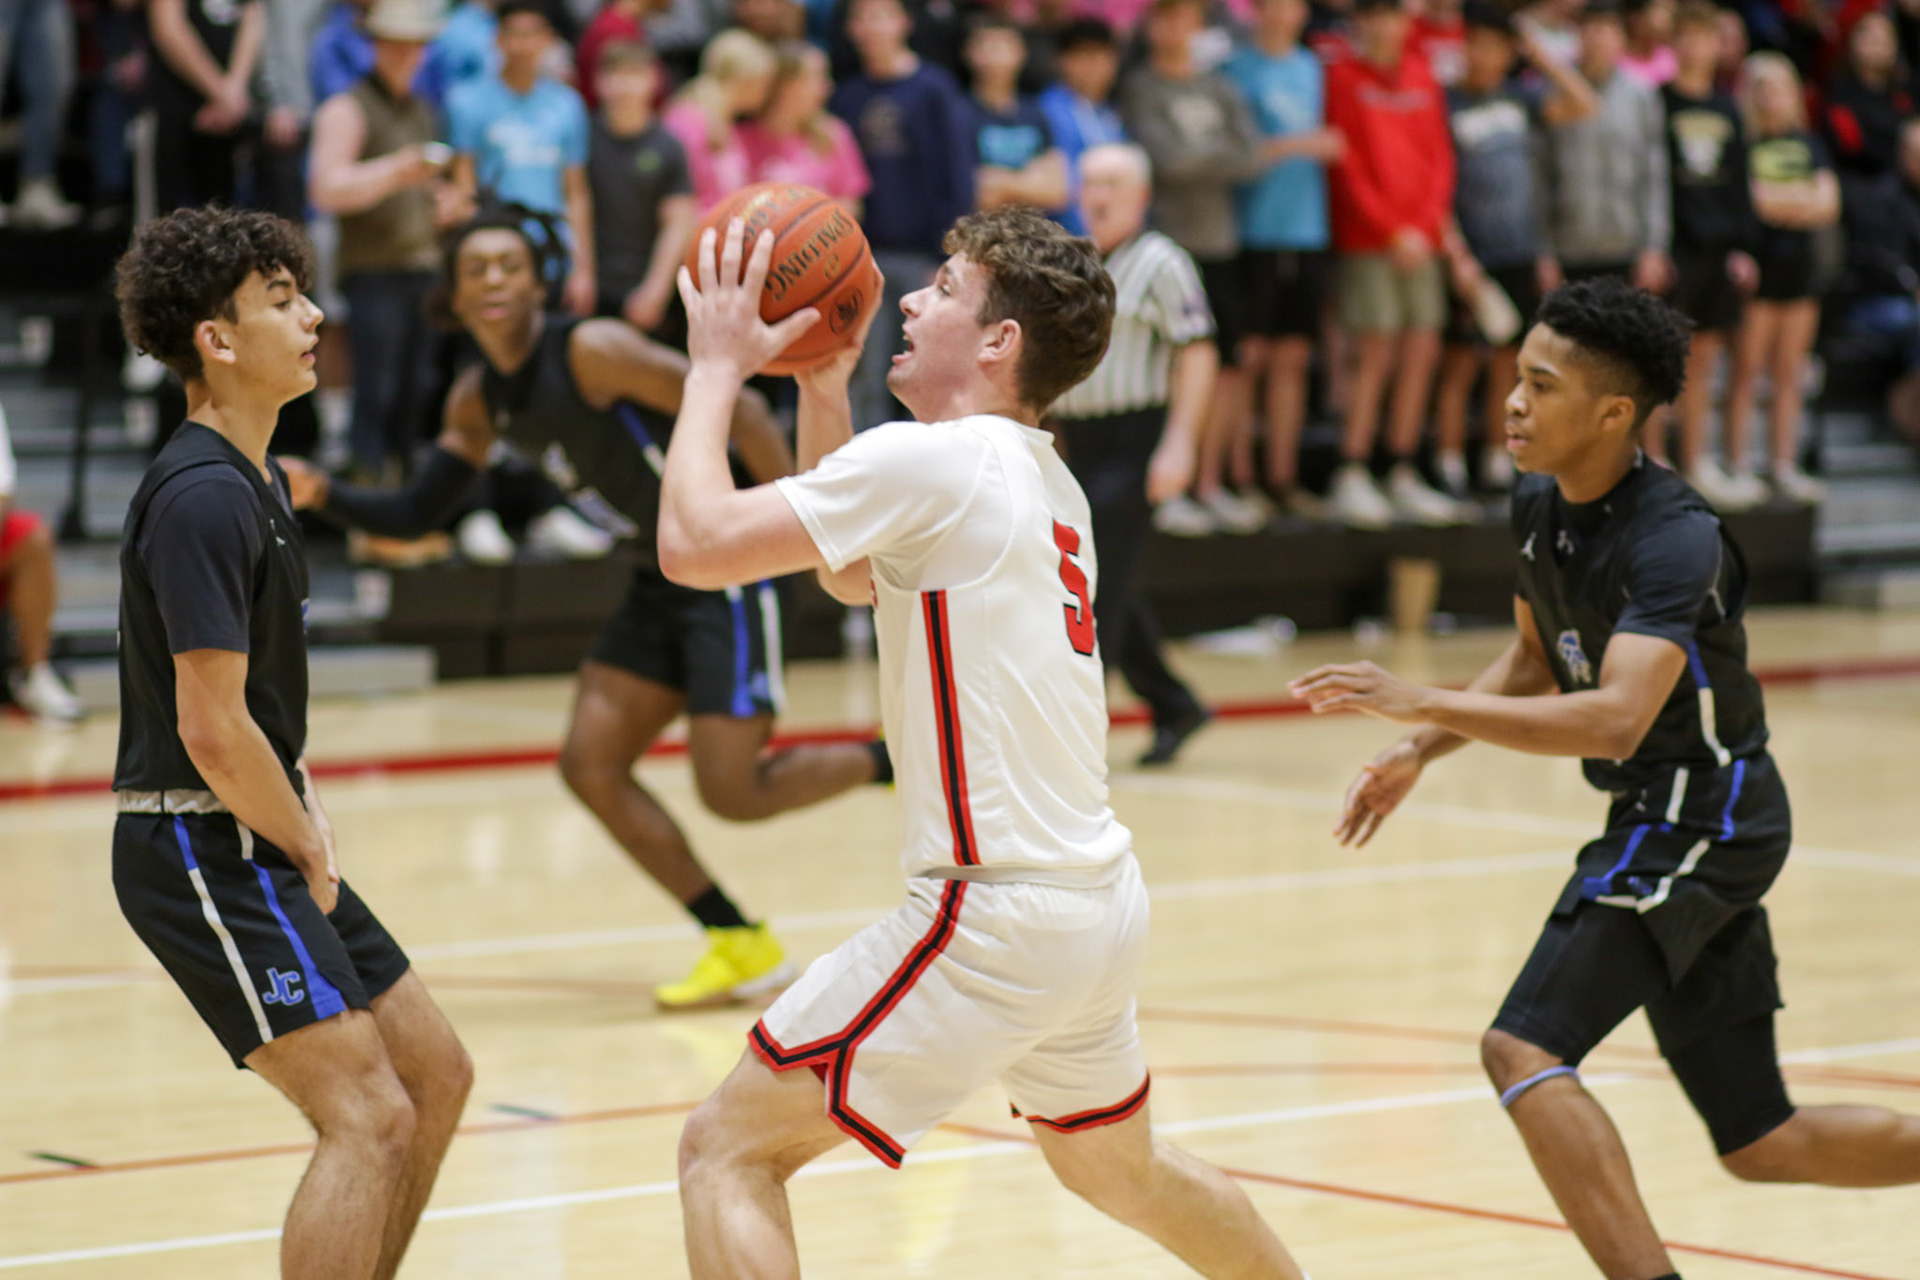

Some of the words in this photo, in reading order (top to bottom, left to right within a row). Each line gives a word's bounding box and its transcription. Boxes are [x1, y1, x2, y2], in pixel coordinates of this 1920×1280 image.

[765, 209, 854, 300] SPALDING
[1053, 518, 1094, 655] 5
[263, 968, 304, 1006] JC
